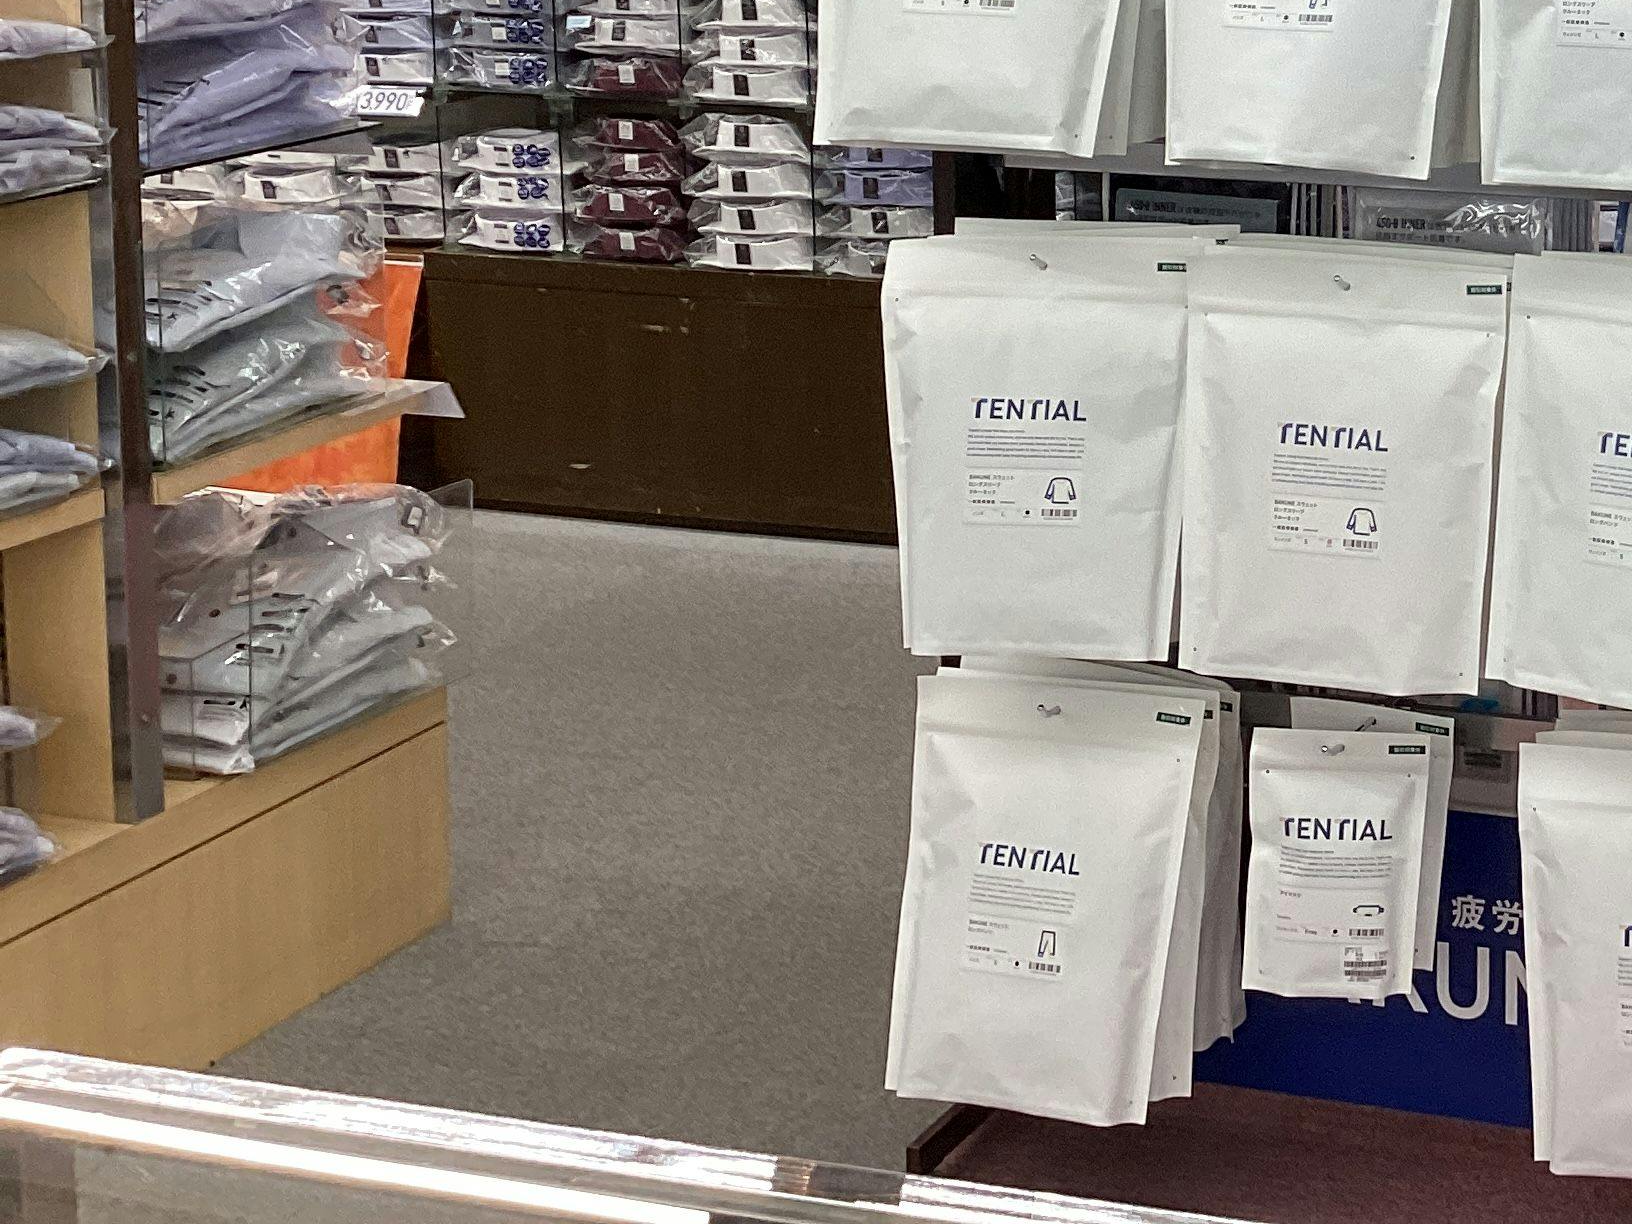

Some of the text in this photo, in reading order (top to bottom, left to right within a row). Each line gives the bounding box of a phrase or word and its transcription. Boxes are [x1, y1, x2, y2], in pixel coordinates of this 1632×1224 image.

[971, 397, 1086, 422] TENTIAL
[1277, 422, 1388, 452] TENTIAL
[1279, 816, 1393, 841] TENTIAL
[978, 840, 1080, 876] TENTIAL
